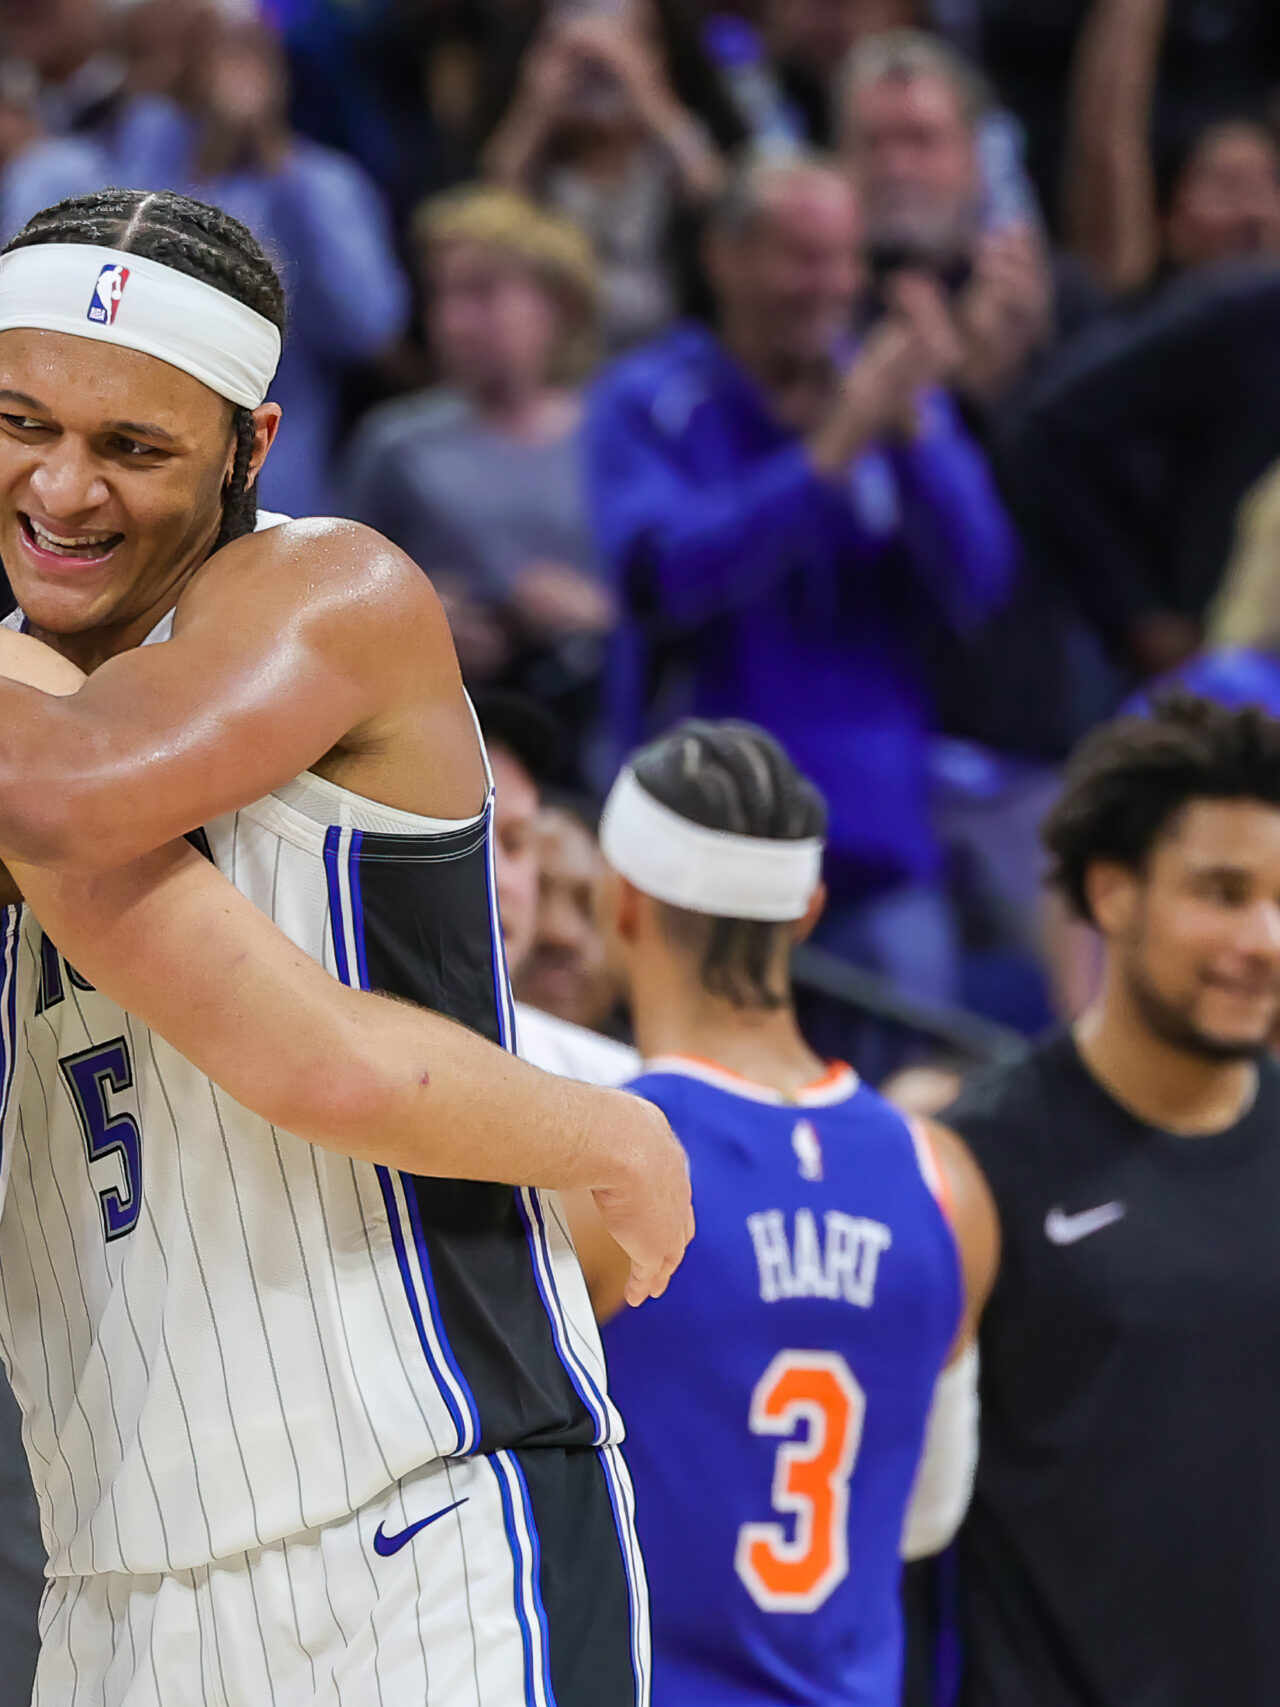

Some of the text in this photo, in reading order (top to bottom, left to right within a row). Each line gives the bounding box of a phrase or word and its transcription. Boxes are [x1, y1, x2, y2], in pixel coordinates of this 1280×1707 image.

[58, 1035, 143, 1243] 5
[746, 1207, 893, 1309] HART
[733, 1348, 867, 1613] 3
